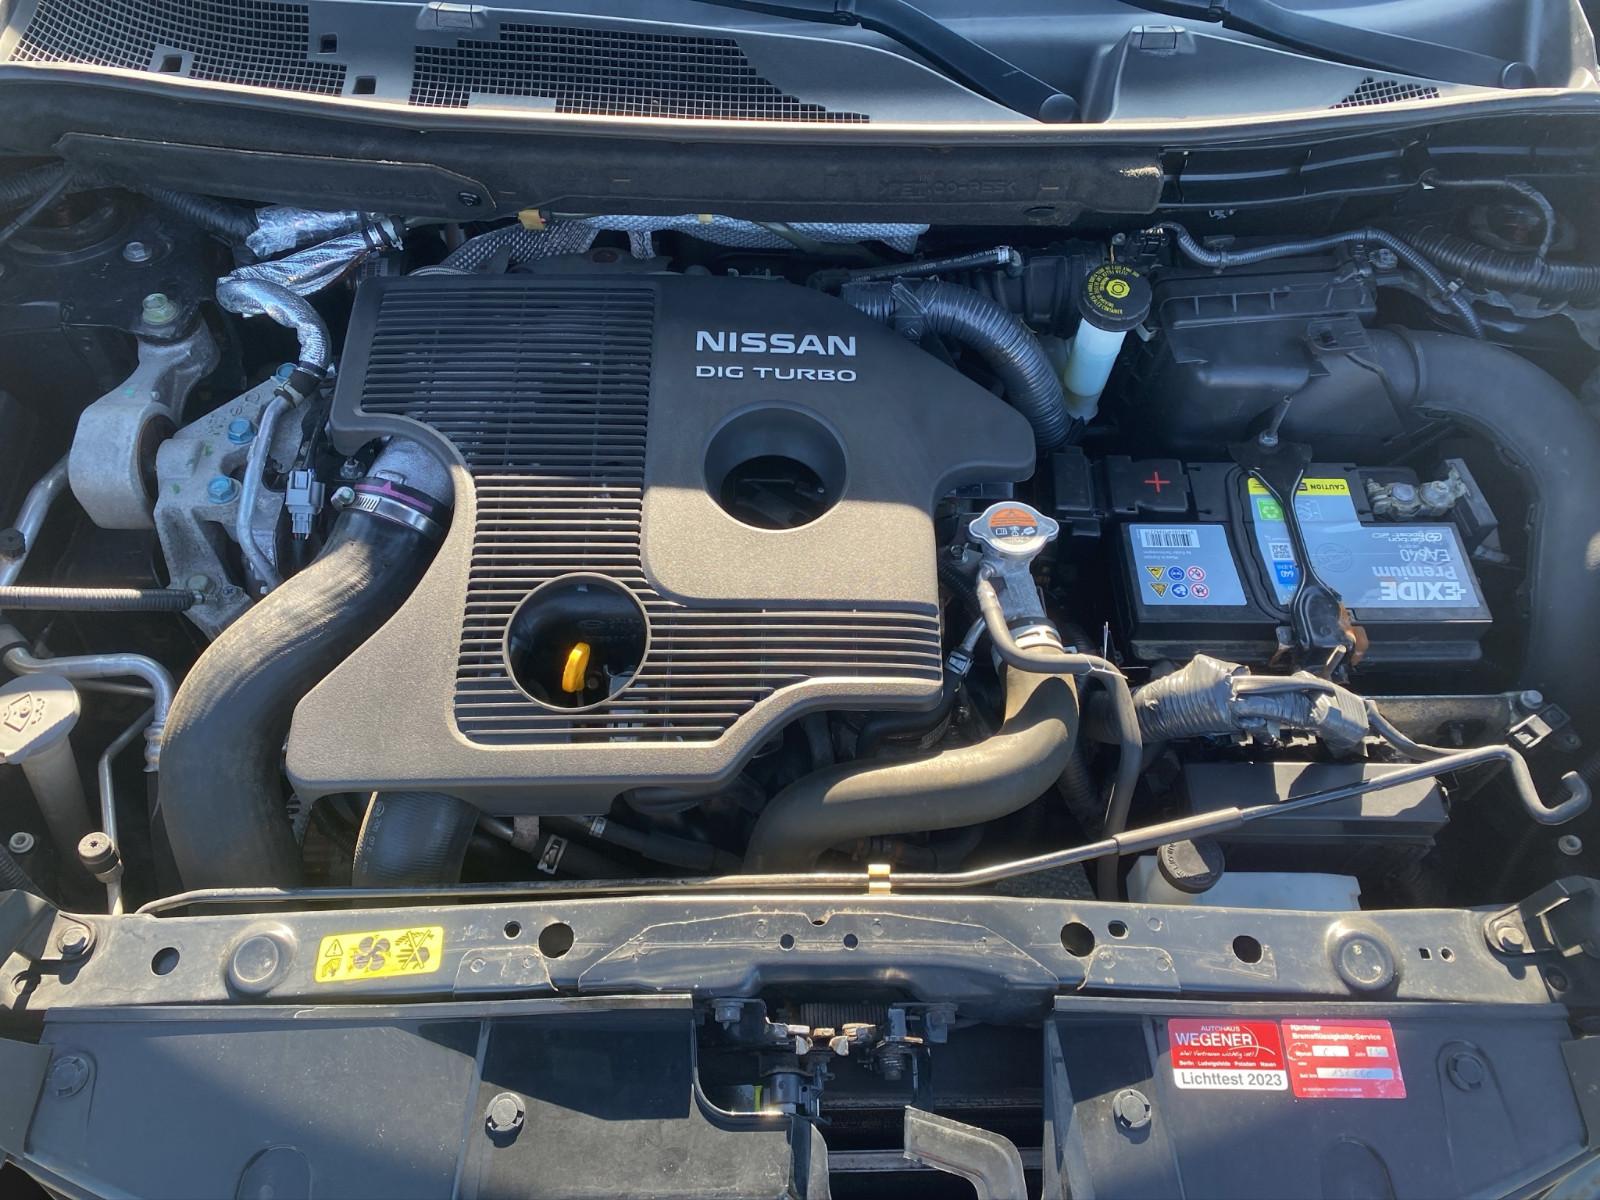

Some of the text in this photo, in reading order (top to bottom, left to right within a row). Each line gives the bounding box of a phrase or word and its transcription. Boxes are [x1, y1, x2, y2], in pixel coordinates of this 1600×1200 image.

[696, 330, 856, 356] NISSAN
[696, 365, 857, 382] DIG TURBO
[1310, 483, 1346, 491] CAUTION
[1400, 548, 1451, 562] EA640
[1371, 566, 1459, 580] Premium
[1378, 581, 1467, 601] EXIDE
[1175, 1032, 1253, 1047] WEGENER
[1181, 1071, 1282, 1087] Lichttest 2023
